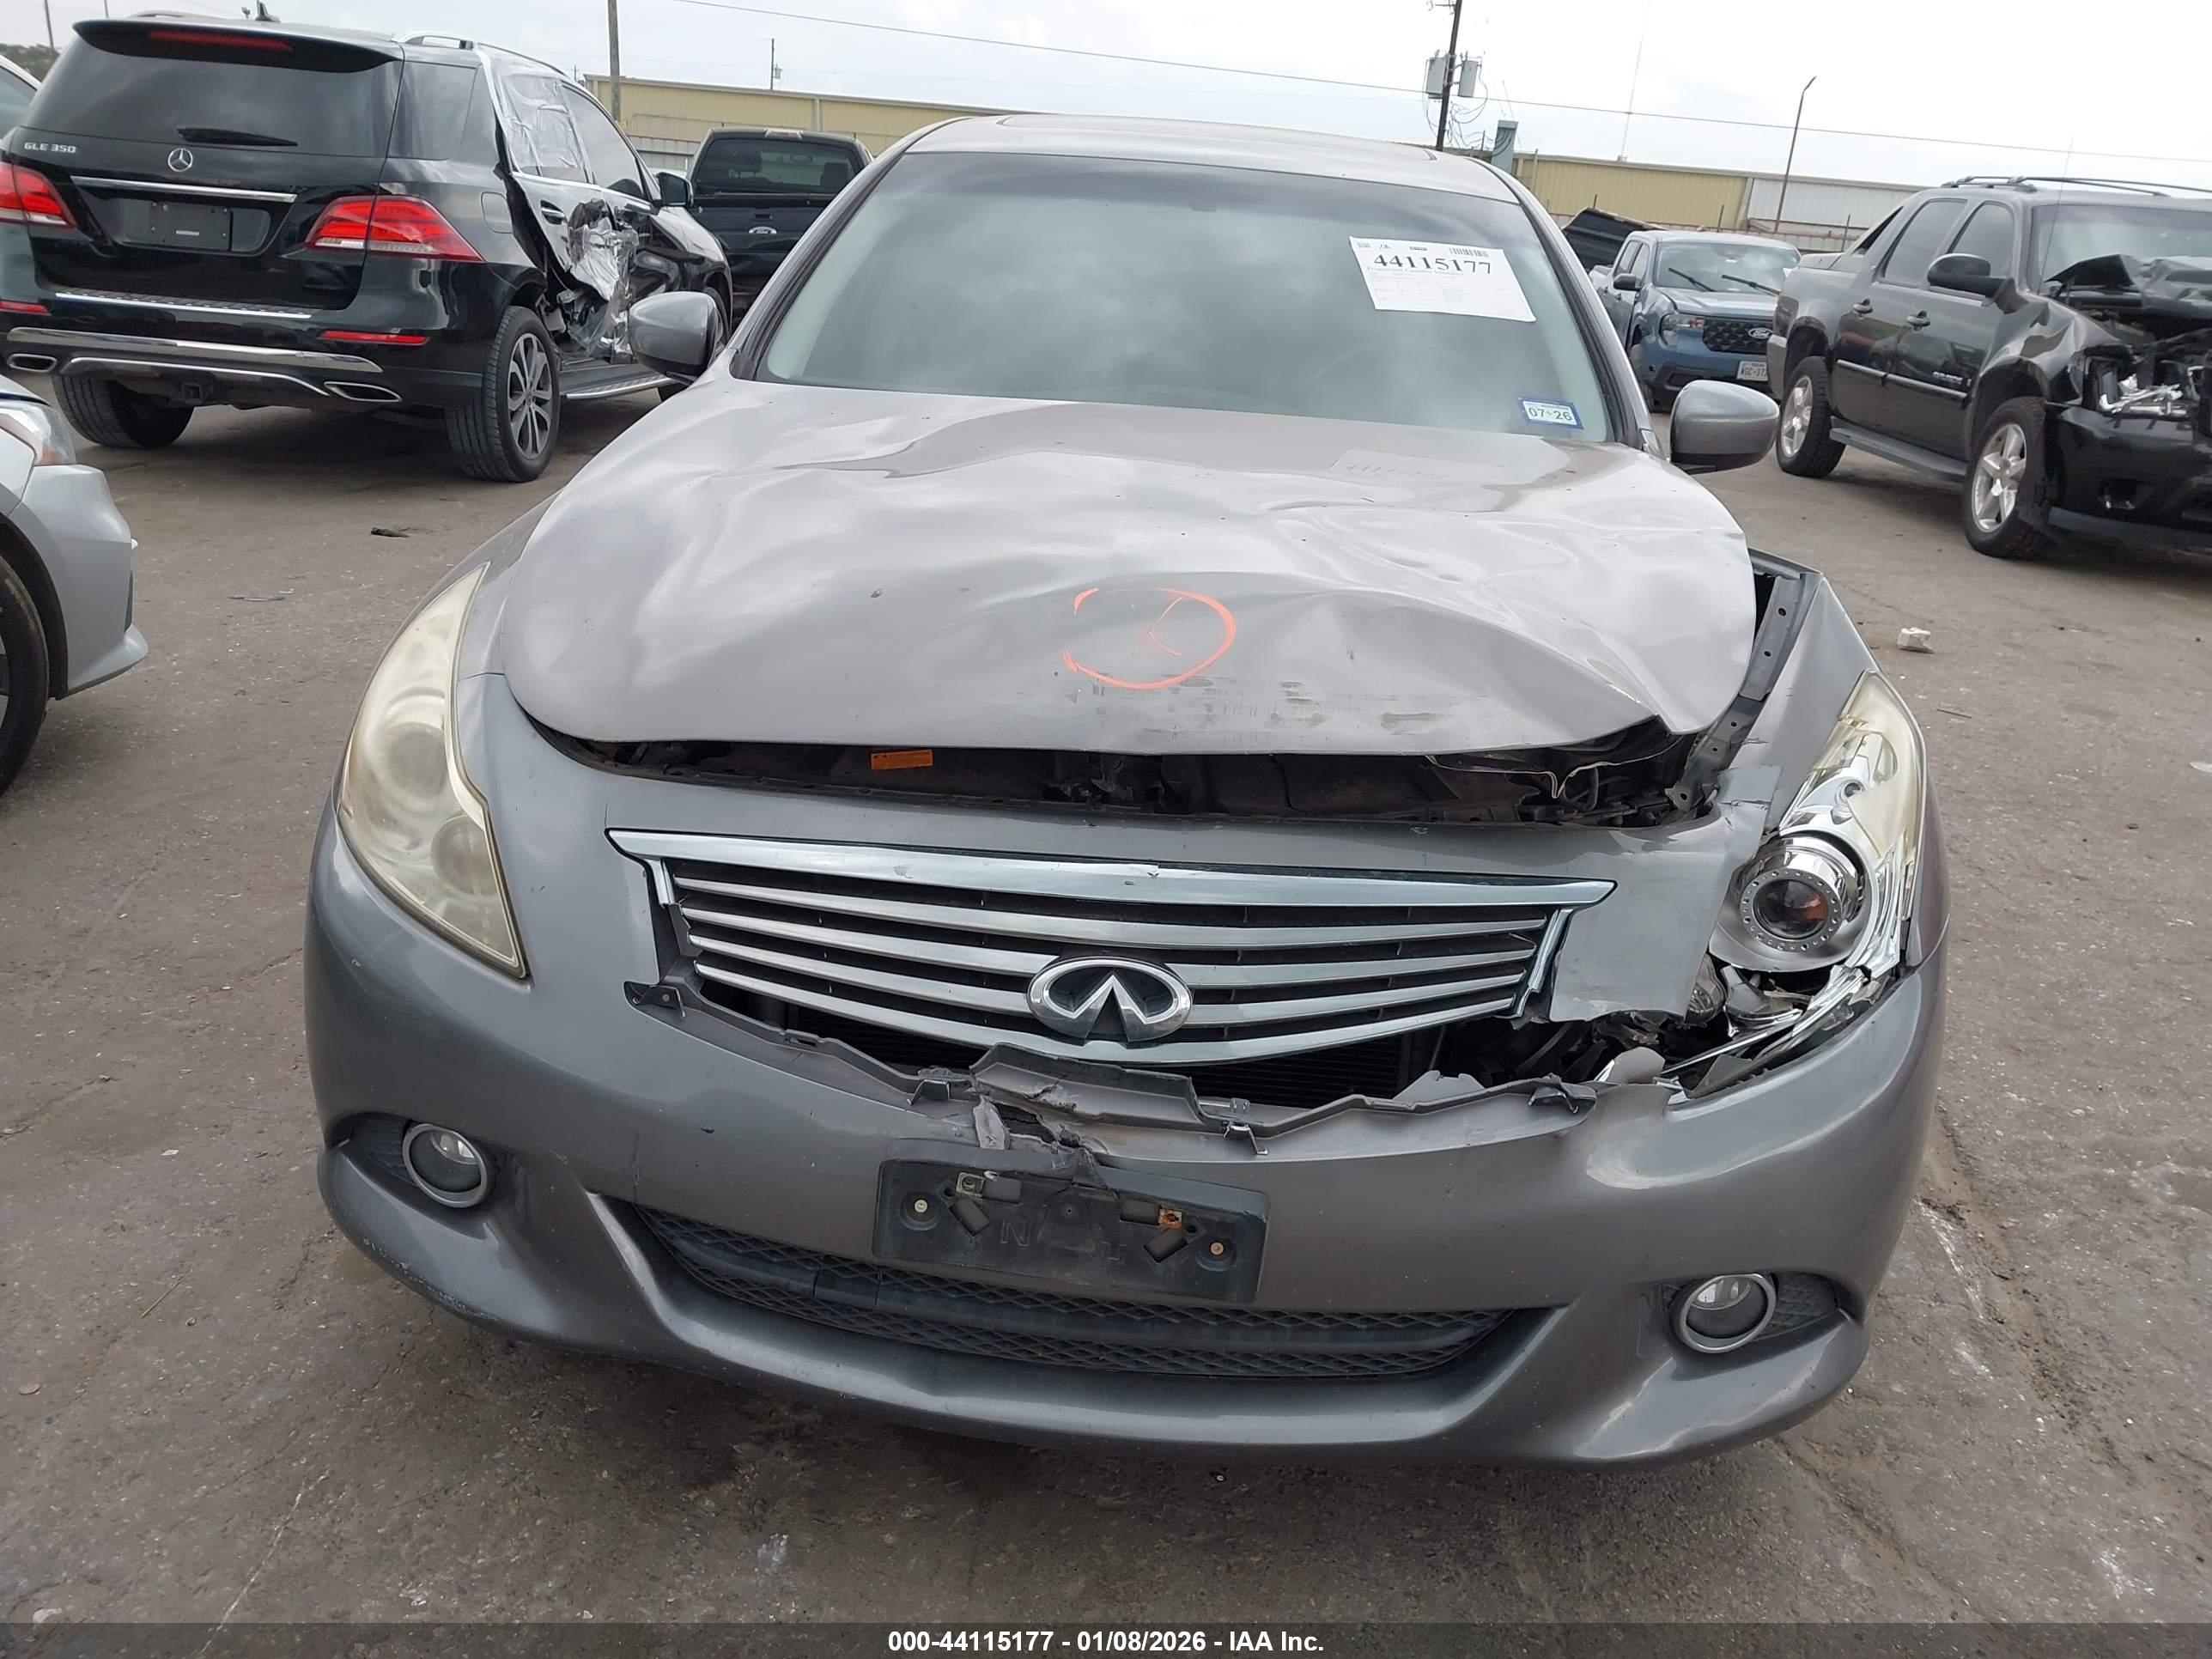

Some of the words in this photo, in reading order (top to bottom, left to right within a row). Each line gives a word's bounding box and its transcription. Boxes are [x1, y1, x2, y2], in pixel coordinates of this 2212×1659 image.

[24, 142, 48, 151] GLE
[51, 143, 76, 153] 350
[1374, 254, 1491, 275] 44115177
